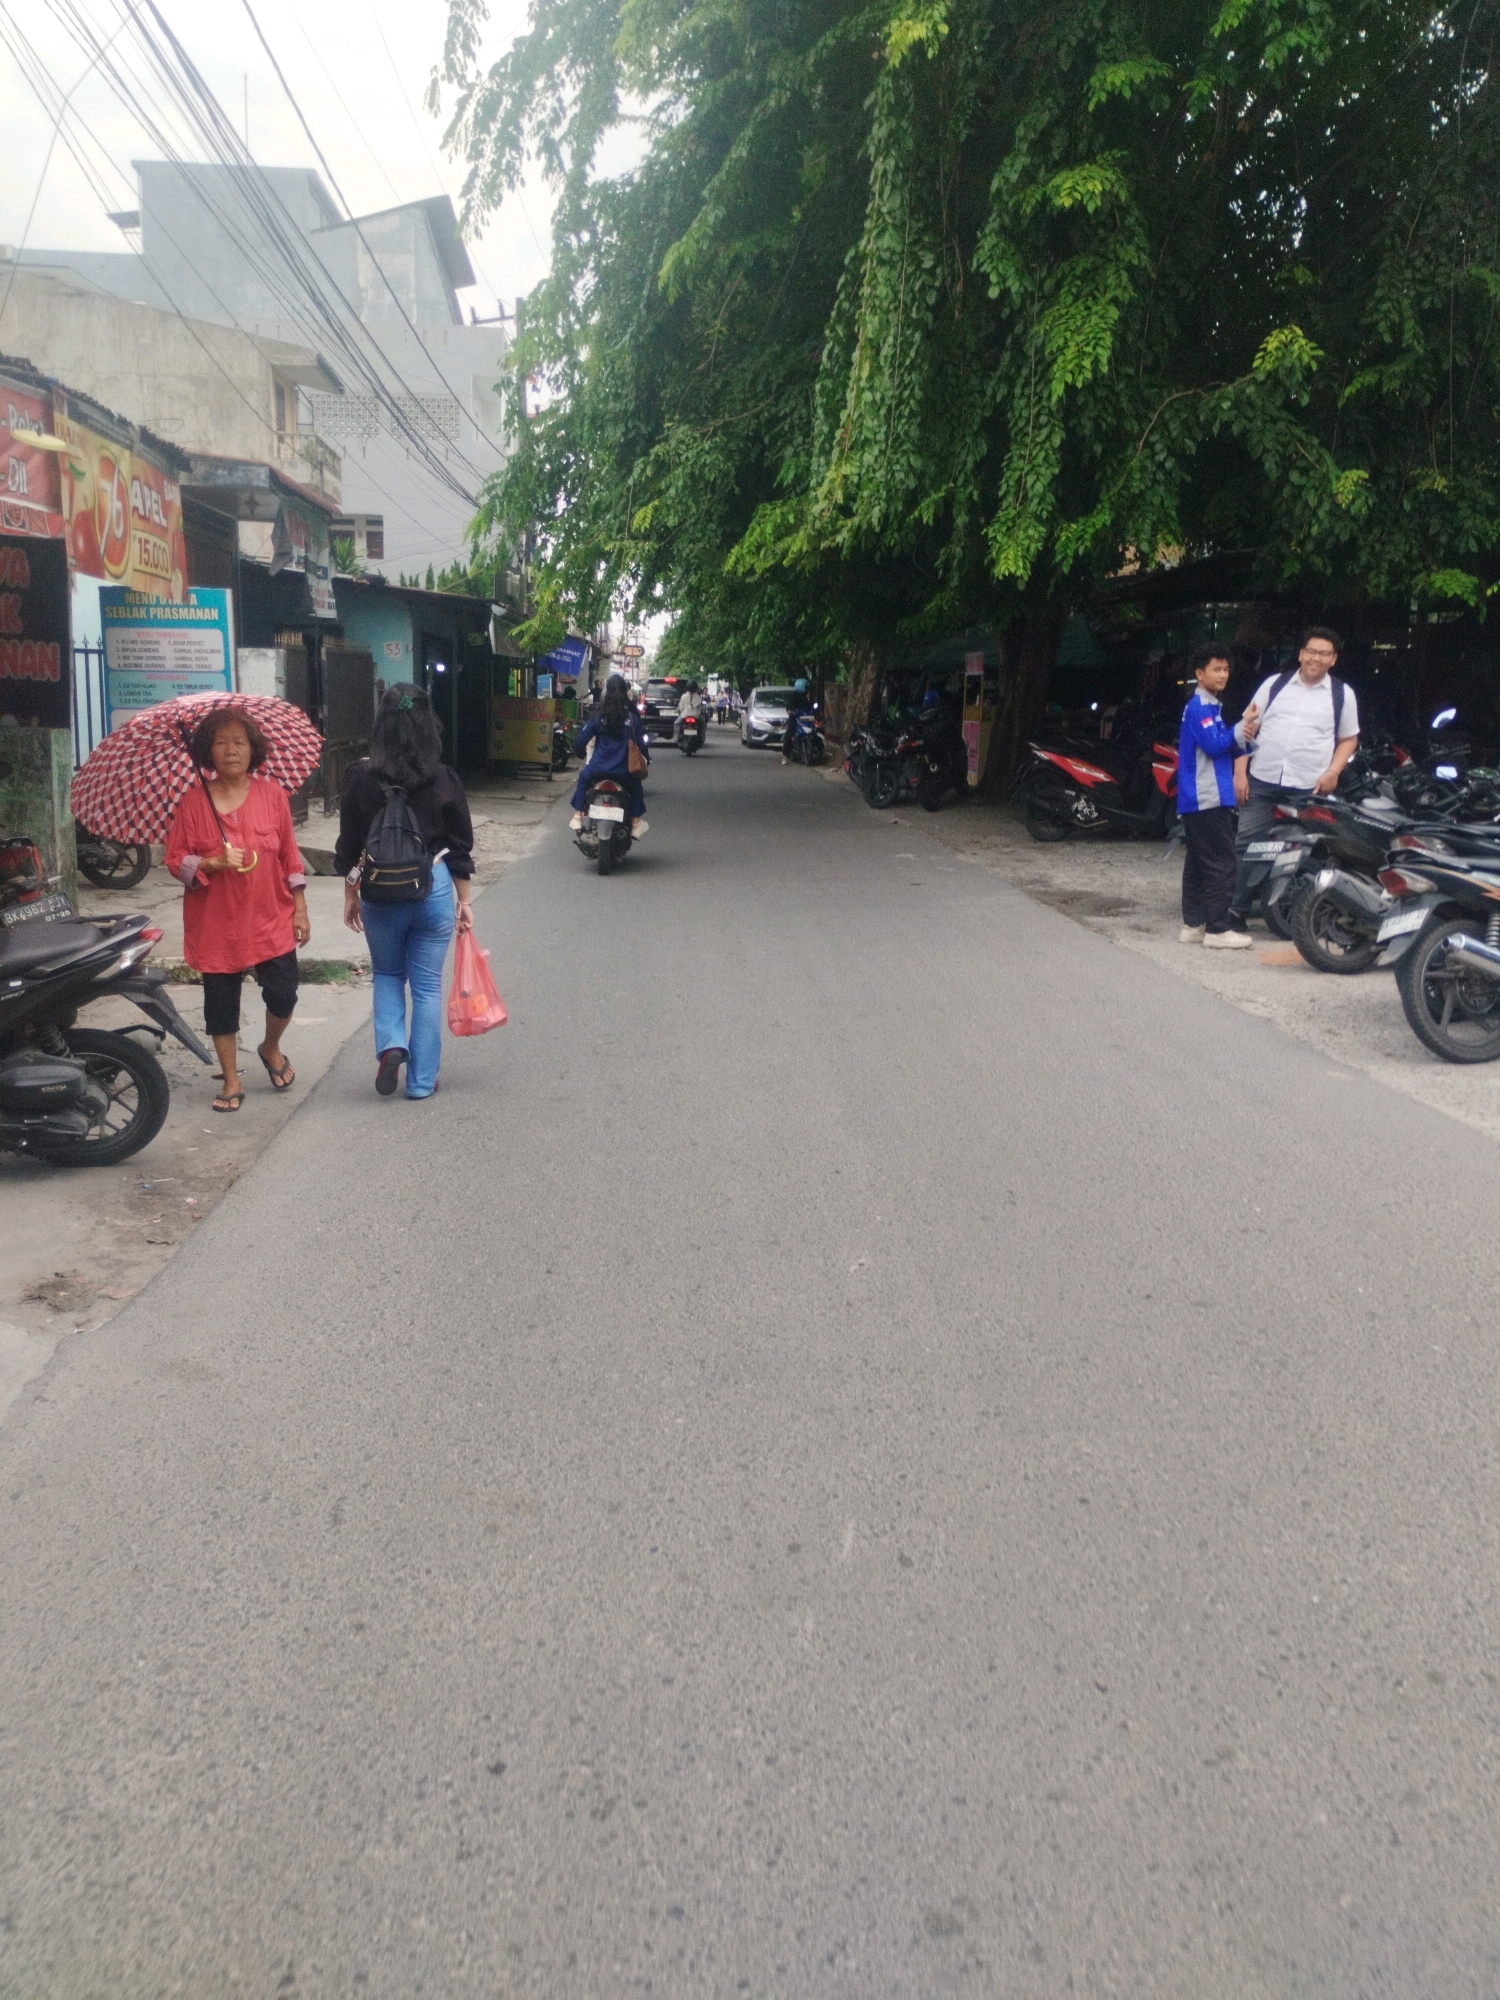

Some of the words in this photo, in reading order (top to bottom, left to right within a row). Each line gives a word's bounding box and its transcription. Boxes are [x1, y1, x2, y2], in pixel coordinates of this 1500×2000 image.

[131, 479, 168, 528] APEL
[138, 536, 169, 573] 15.000
[125, 592, 156, 605] MENU
[105, 606, 148, 619] SEBLAK
[150, 607, 218, 620] PRASMANAN
[386, 643, 400, 655] 53
[5, 911, 20, 924] BK
